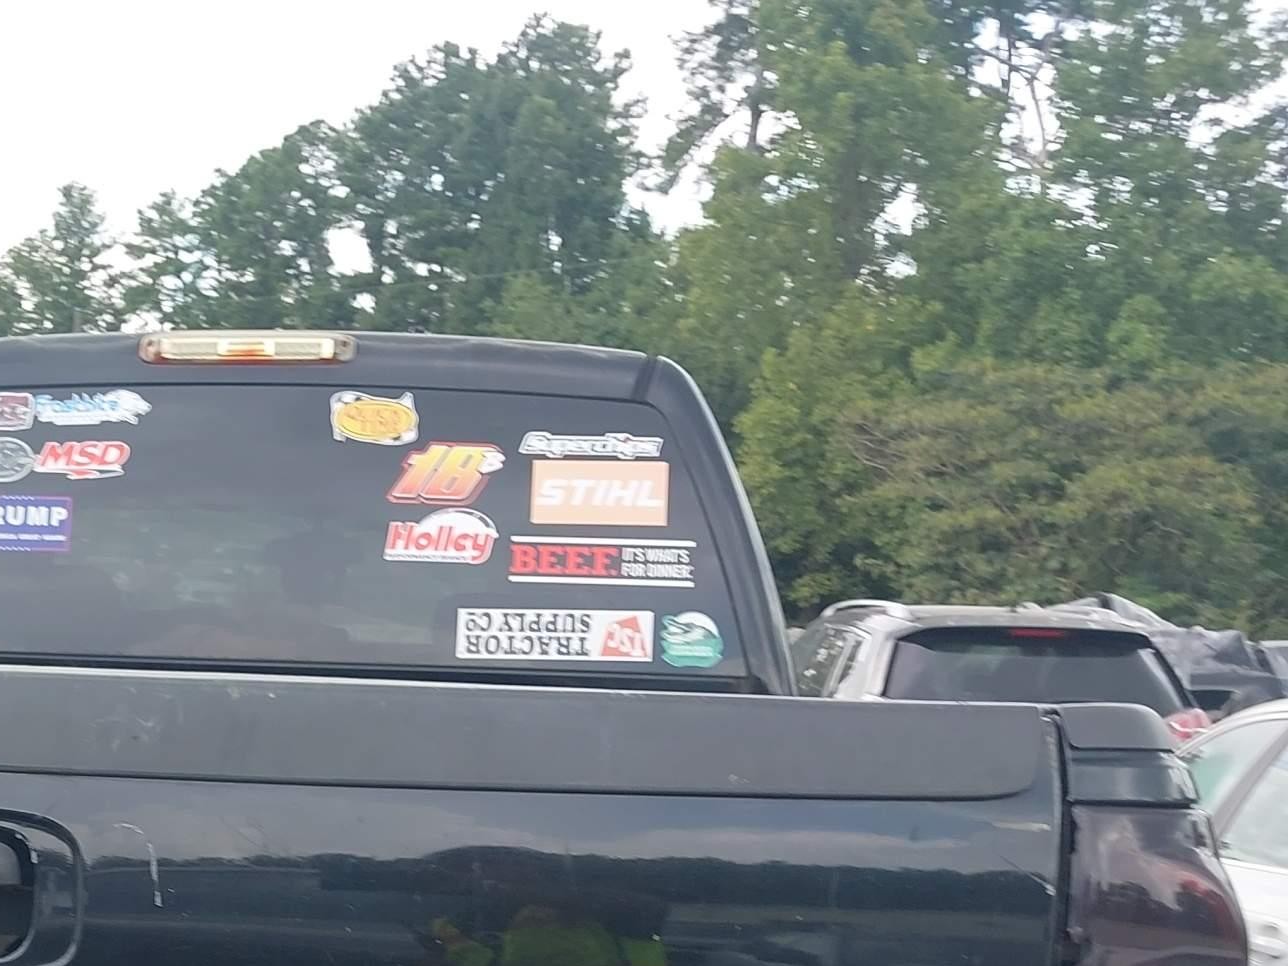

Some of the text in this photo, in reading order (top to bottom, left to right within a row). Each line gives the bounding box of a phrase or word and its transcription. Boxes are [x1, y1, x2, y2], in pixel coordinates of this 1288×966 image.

[39, 441, 130, 468] MSD
[388, 443, 497, 502] 18
[535, 479, 663, 508] STIHL
[388, 522, 492, 562] Holley
[621, 562, 646, 577] FOR
[500, 612, 592, 633] SUPPLY
[466, 634, 590, 656] TRACTOR
